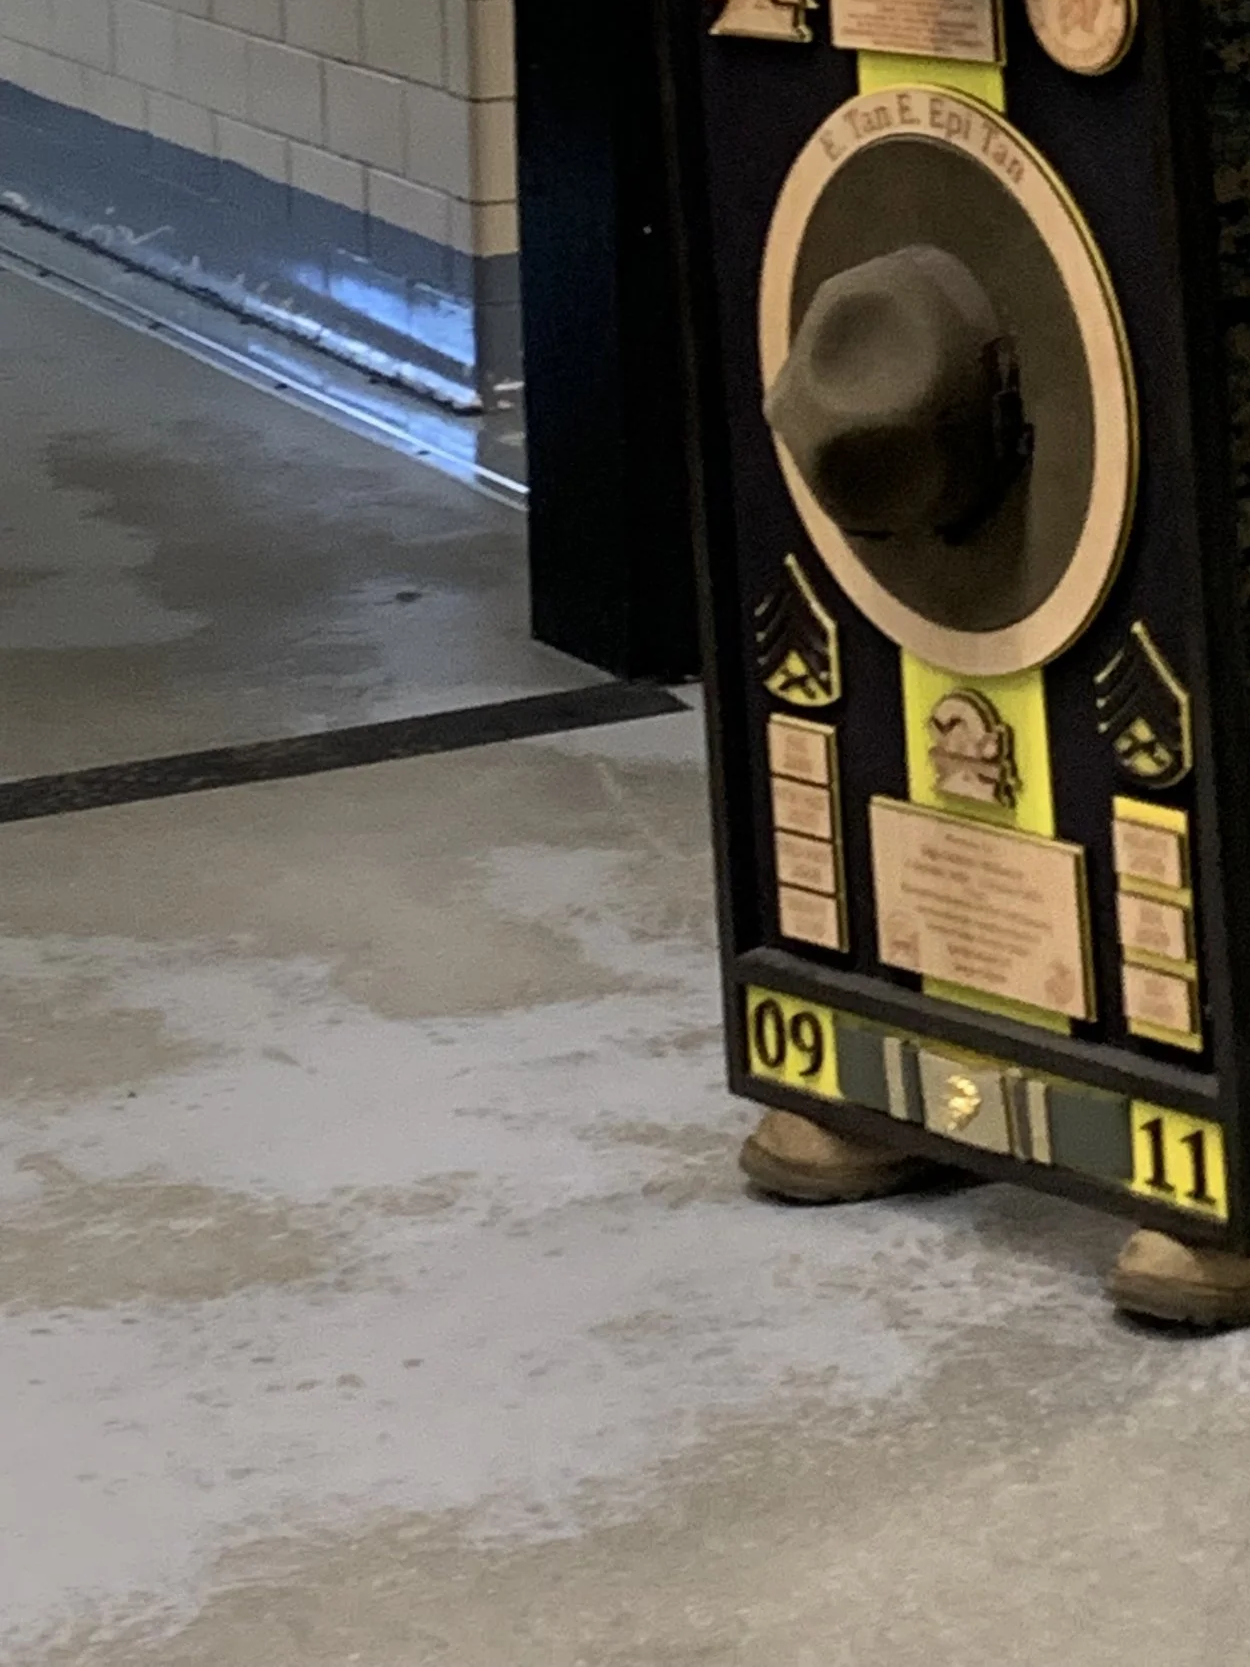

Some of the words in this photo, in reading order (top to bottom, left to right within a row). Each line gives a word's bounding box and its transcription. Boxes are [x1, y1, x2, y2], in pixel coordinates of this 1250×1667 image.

[842, 105, 893, 139] Tan
[929, 97, 972, 138] Epi
[754, 997, 824, 1077] 09
[1139, 1116, 1217, 1207] 11
